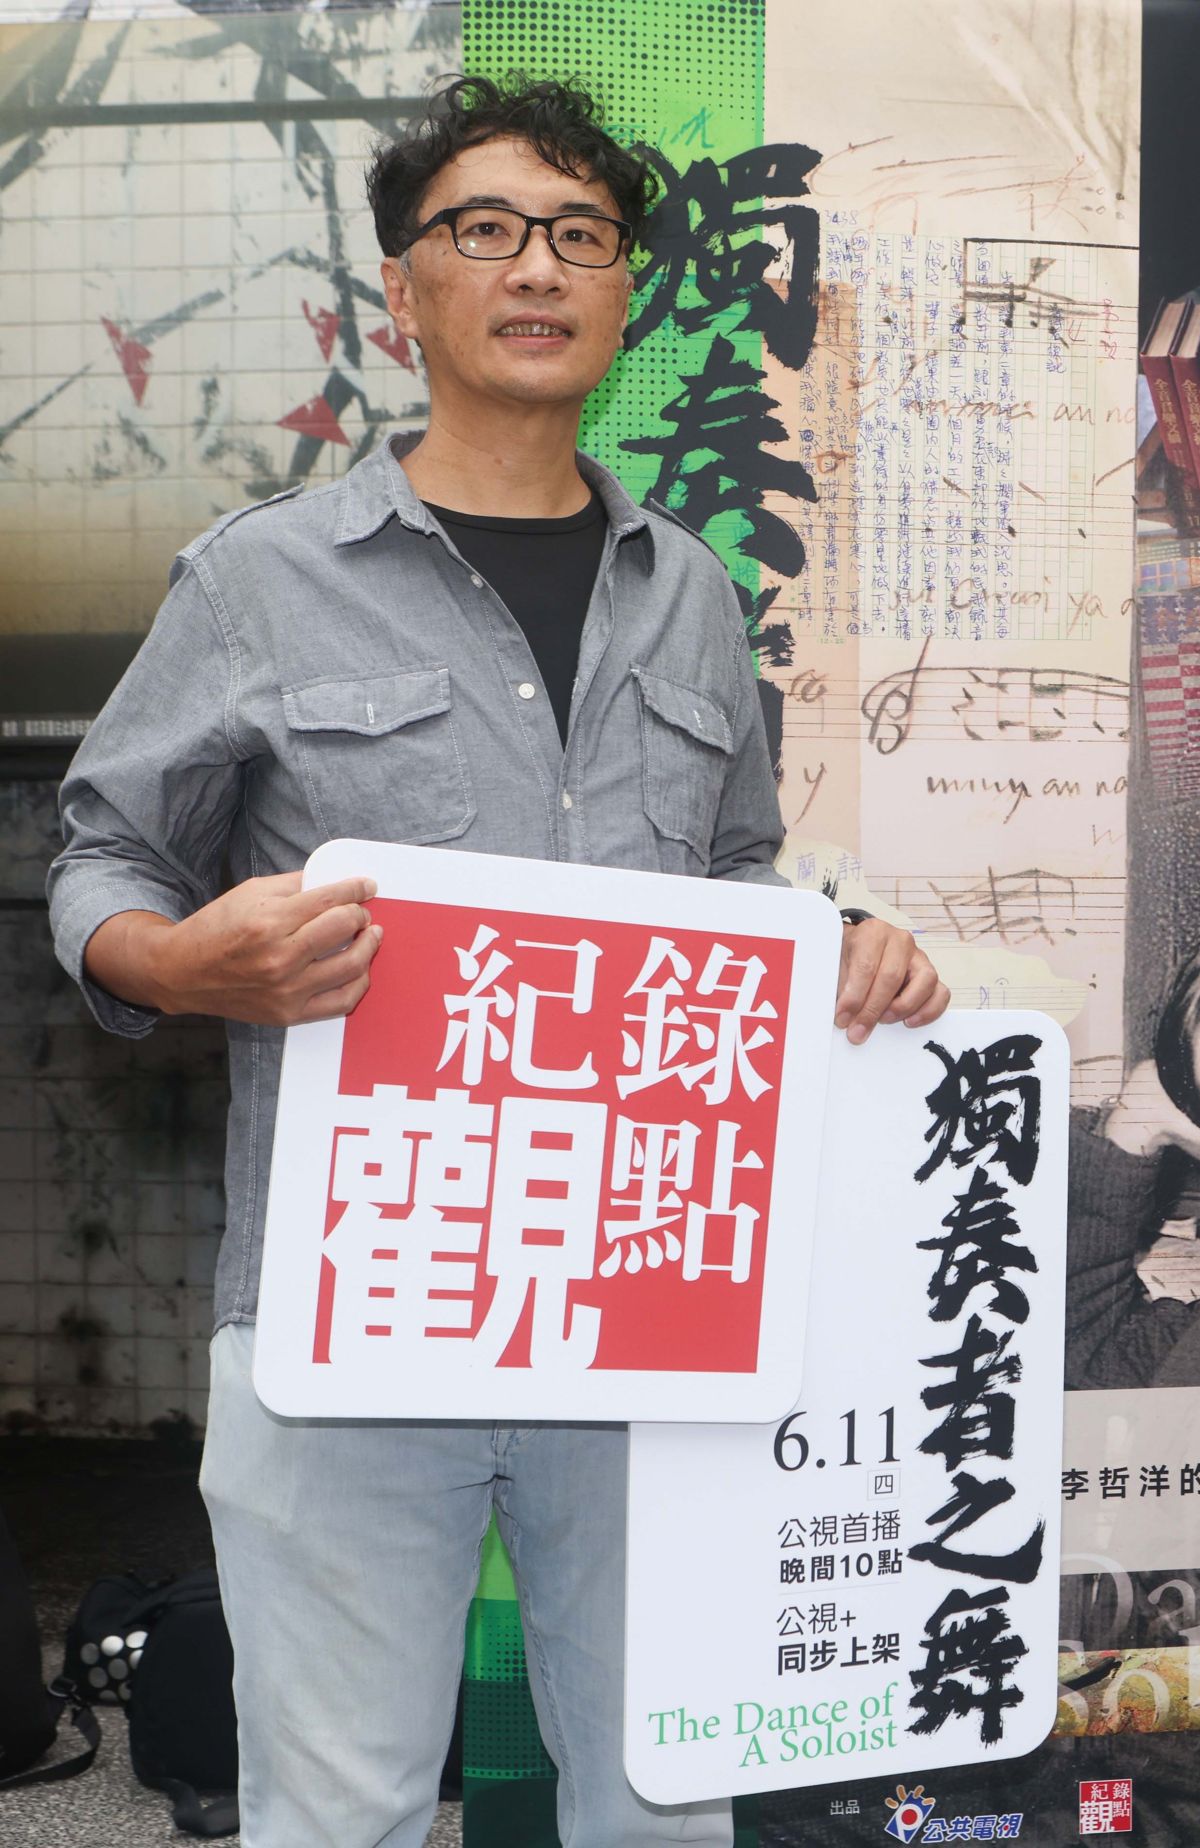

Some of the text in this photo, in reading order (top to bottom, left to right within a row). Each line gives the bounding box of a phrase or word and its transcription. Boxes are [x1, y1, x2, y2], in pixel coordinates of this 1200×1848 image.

[435, 923, 779, 1106] 紀錄
[320, 1084, 766, 1369] 觀點
[903, 1033, 1046, 1750] 獨奏者之舞
[773, 1406, 901, 1471] 6.11
[777, 1510, 900, 1549] 公視首播
[779, 1550, 902, 1584] 晚間10點
[776, 1602, 857, 1637] 公視+
[777, 1633, 900, 1676] 同步上架
[648, 1681, 899, 1746] The Dance of
[738, 1719, 898, 1768] A Soloist
[1091, 1783, 1131, 1801] 紀錄
[830, 1800, 1024, 1844] 出品 公共電視
